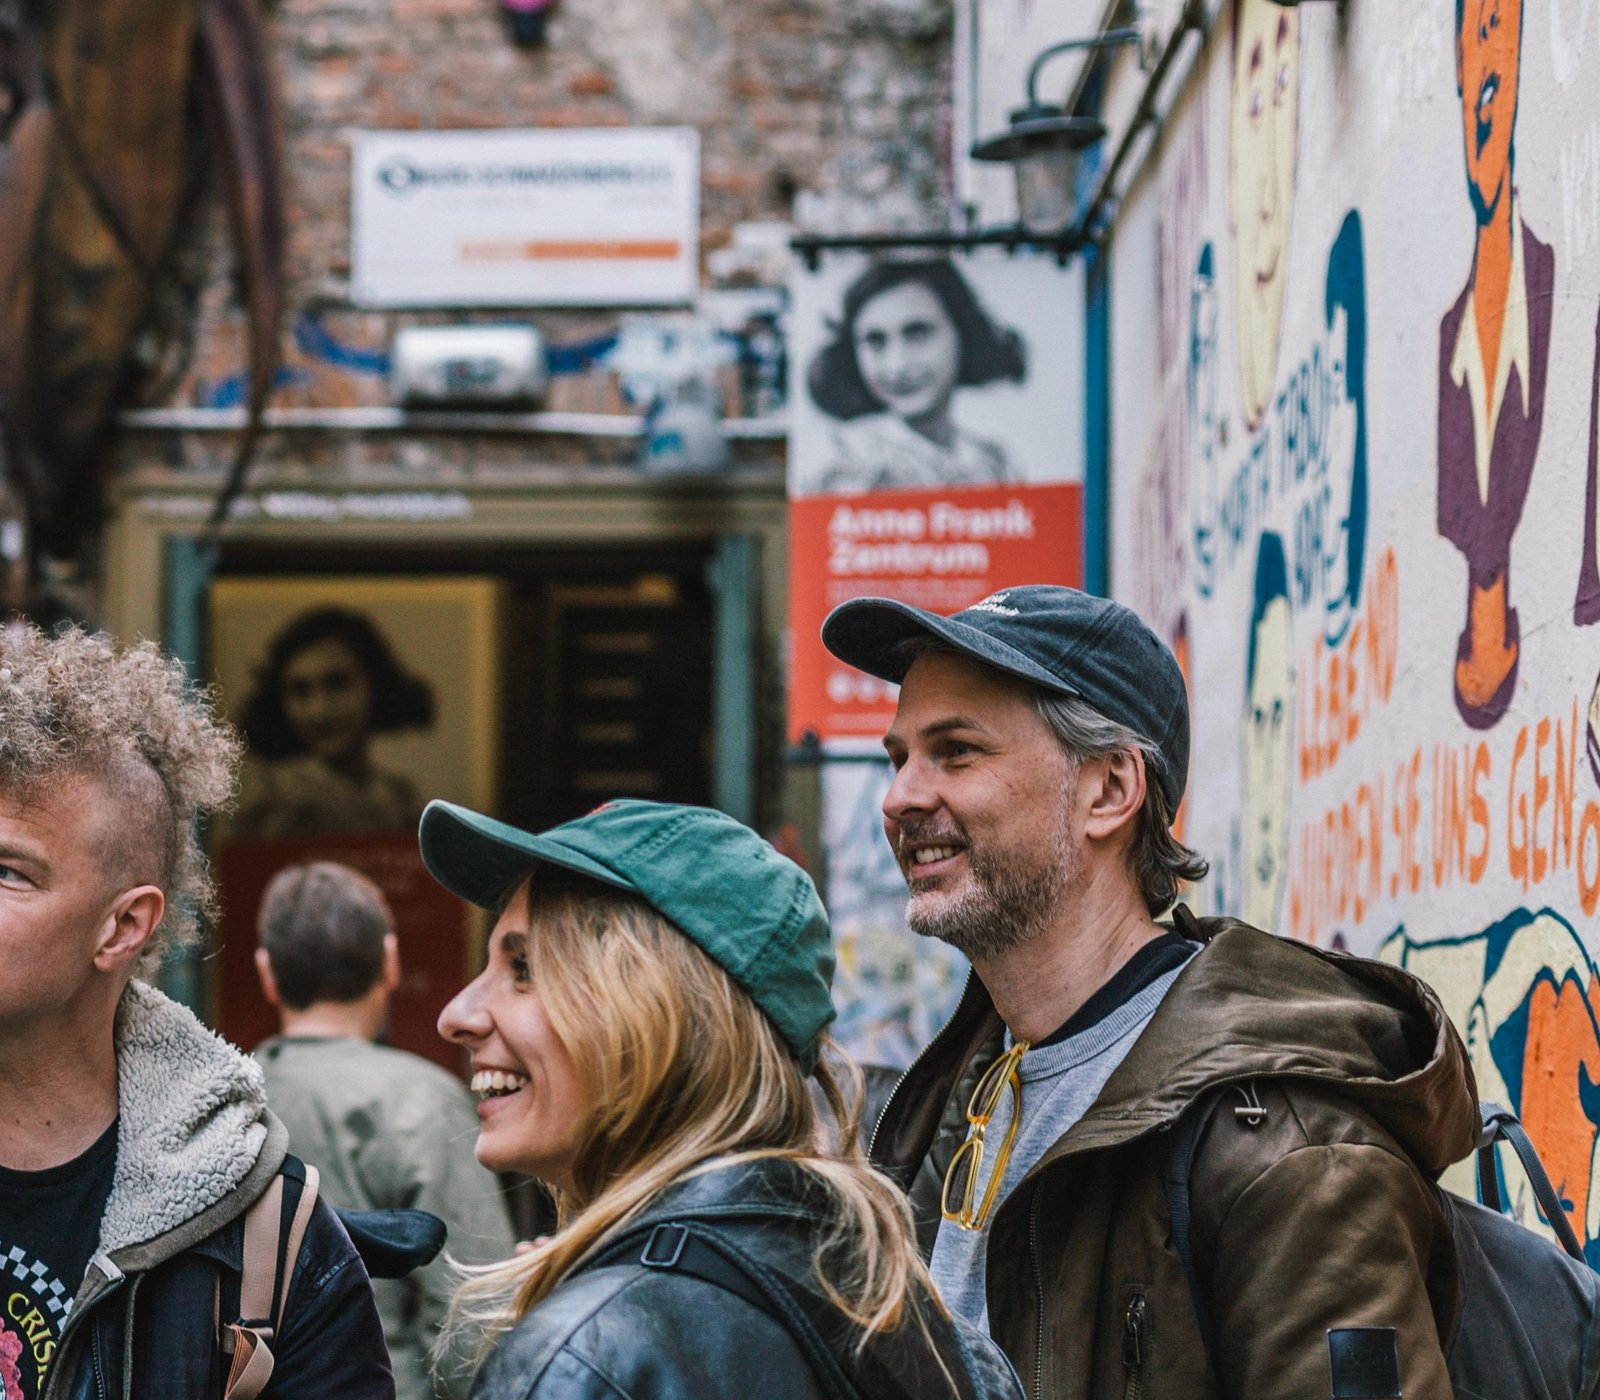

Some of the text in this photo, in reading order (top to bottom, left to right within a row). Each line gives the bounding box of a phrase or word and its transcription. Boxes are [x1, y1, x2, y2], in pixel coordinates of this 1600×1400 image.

[829, 500, 1035, 540] Anne Frank
[829, 540, 989, 574] Zentrum
[1432, 741, 1490, 887] UNS
[7, 1292, 56, 1390] CRIS
